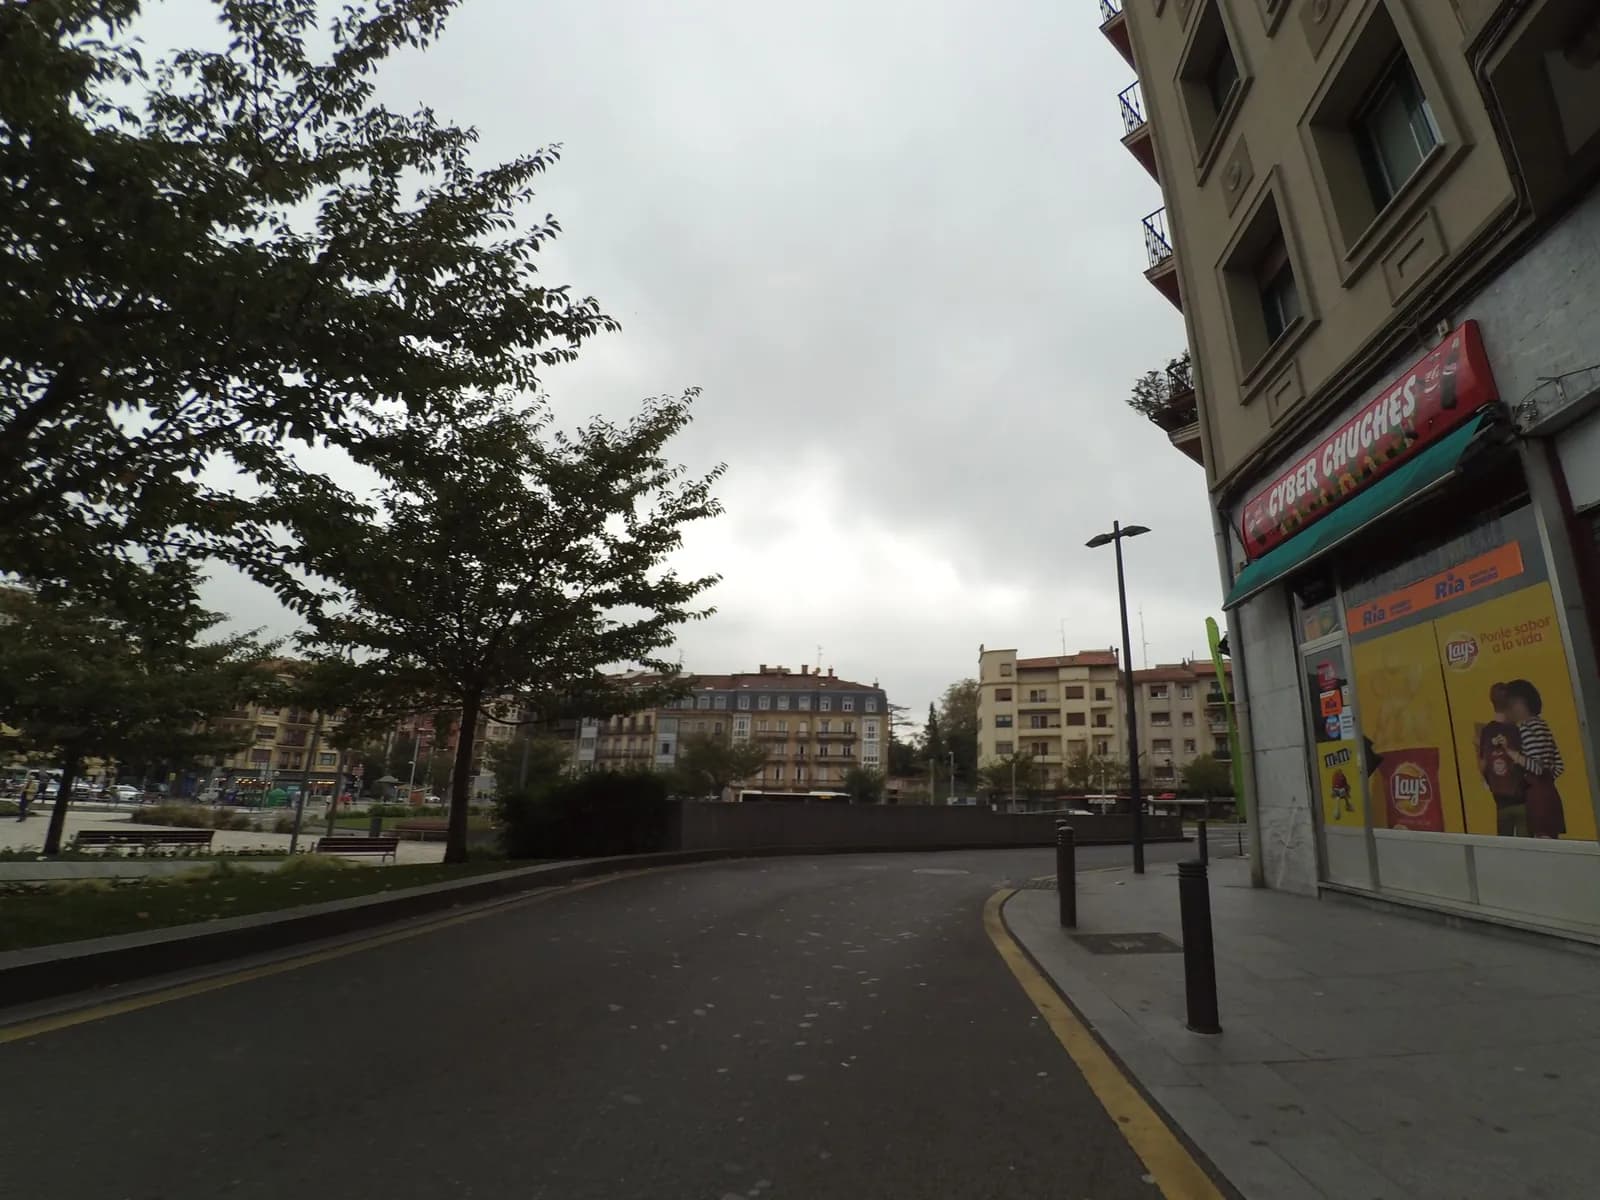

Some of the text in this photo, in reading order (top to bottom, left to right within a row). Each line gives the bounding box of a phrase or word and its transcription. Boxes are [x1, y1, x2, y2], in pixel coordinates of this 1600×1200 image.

[1269, 375, 1416, 517] CYBER CHUCHES
[1435, 575, 1465, 599] Ria
[1363, 605, 1385, 626] Ria
[1480, 615, 1552, 644] Ponle sabor
[1502, 639, 1513, 651] la
[1516, 631, 1543, 647] vida
[1395, 774, 1427, 806] Lay's
